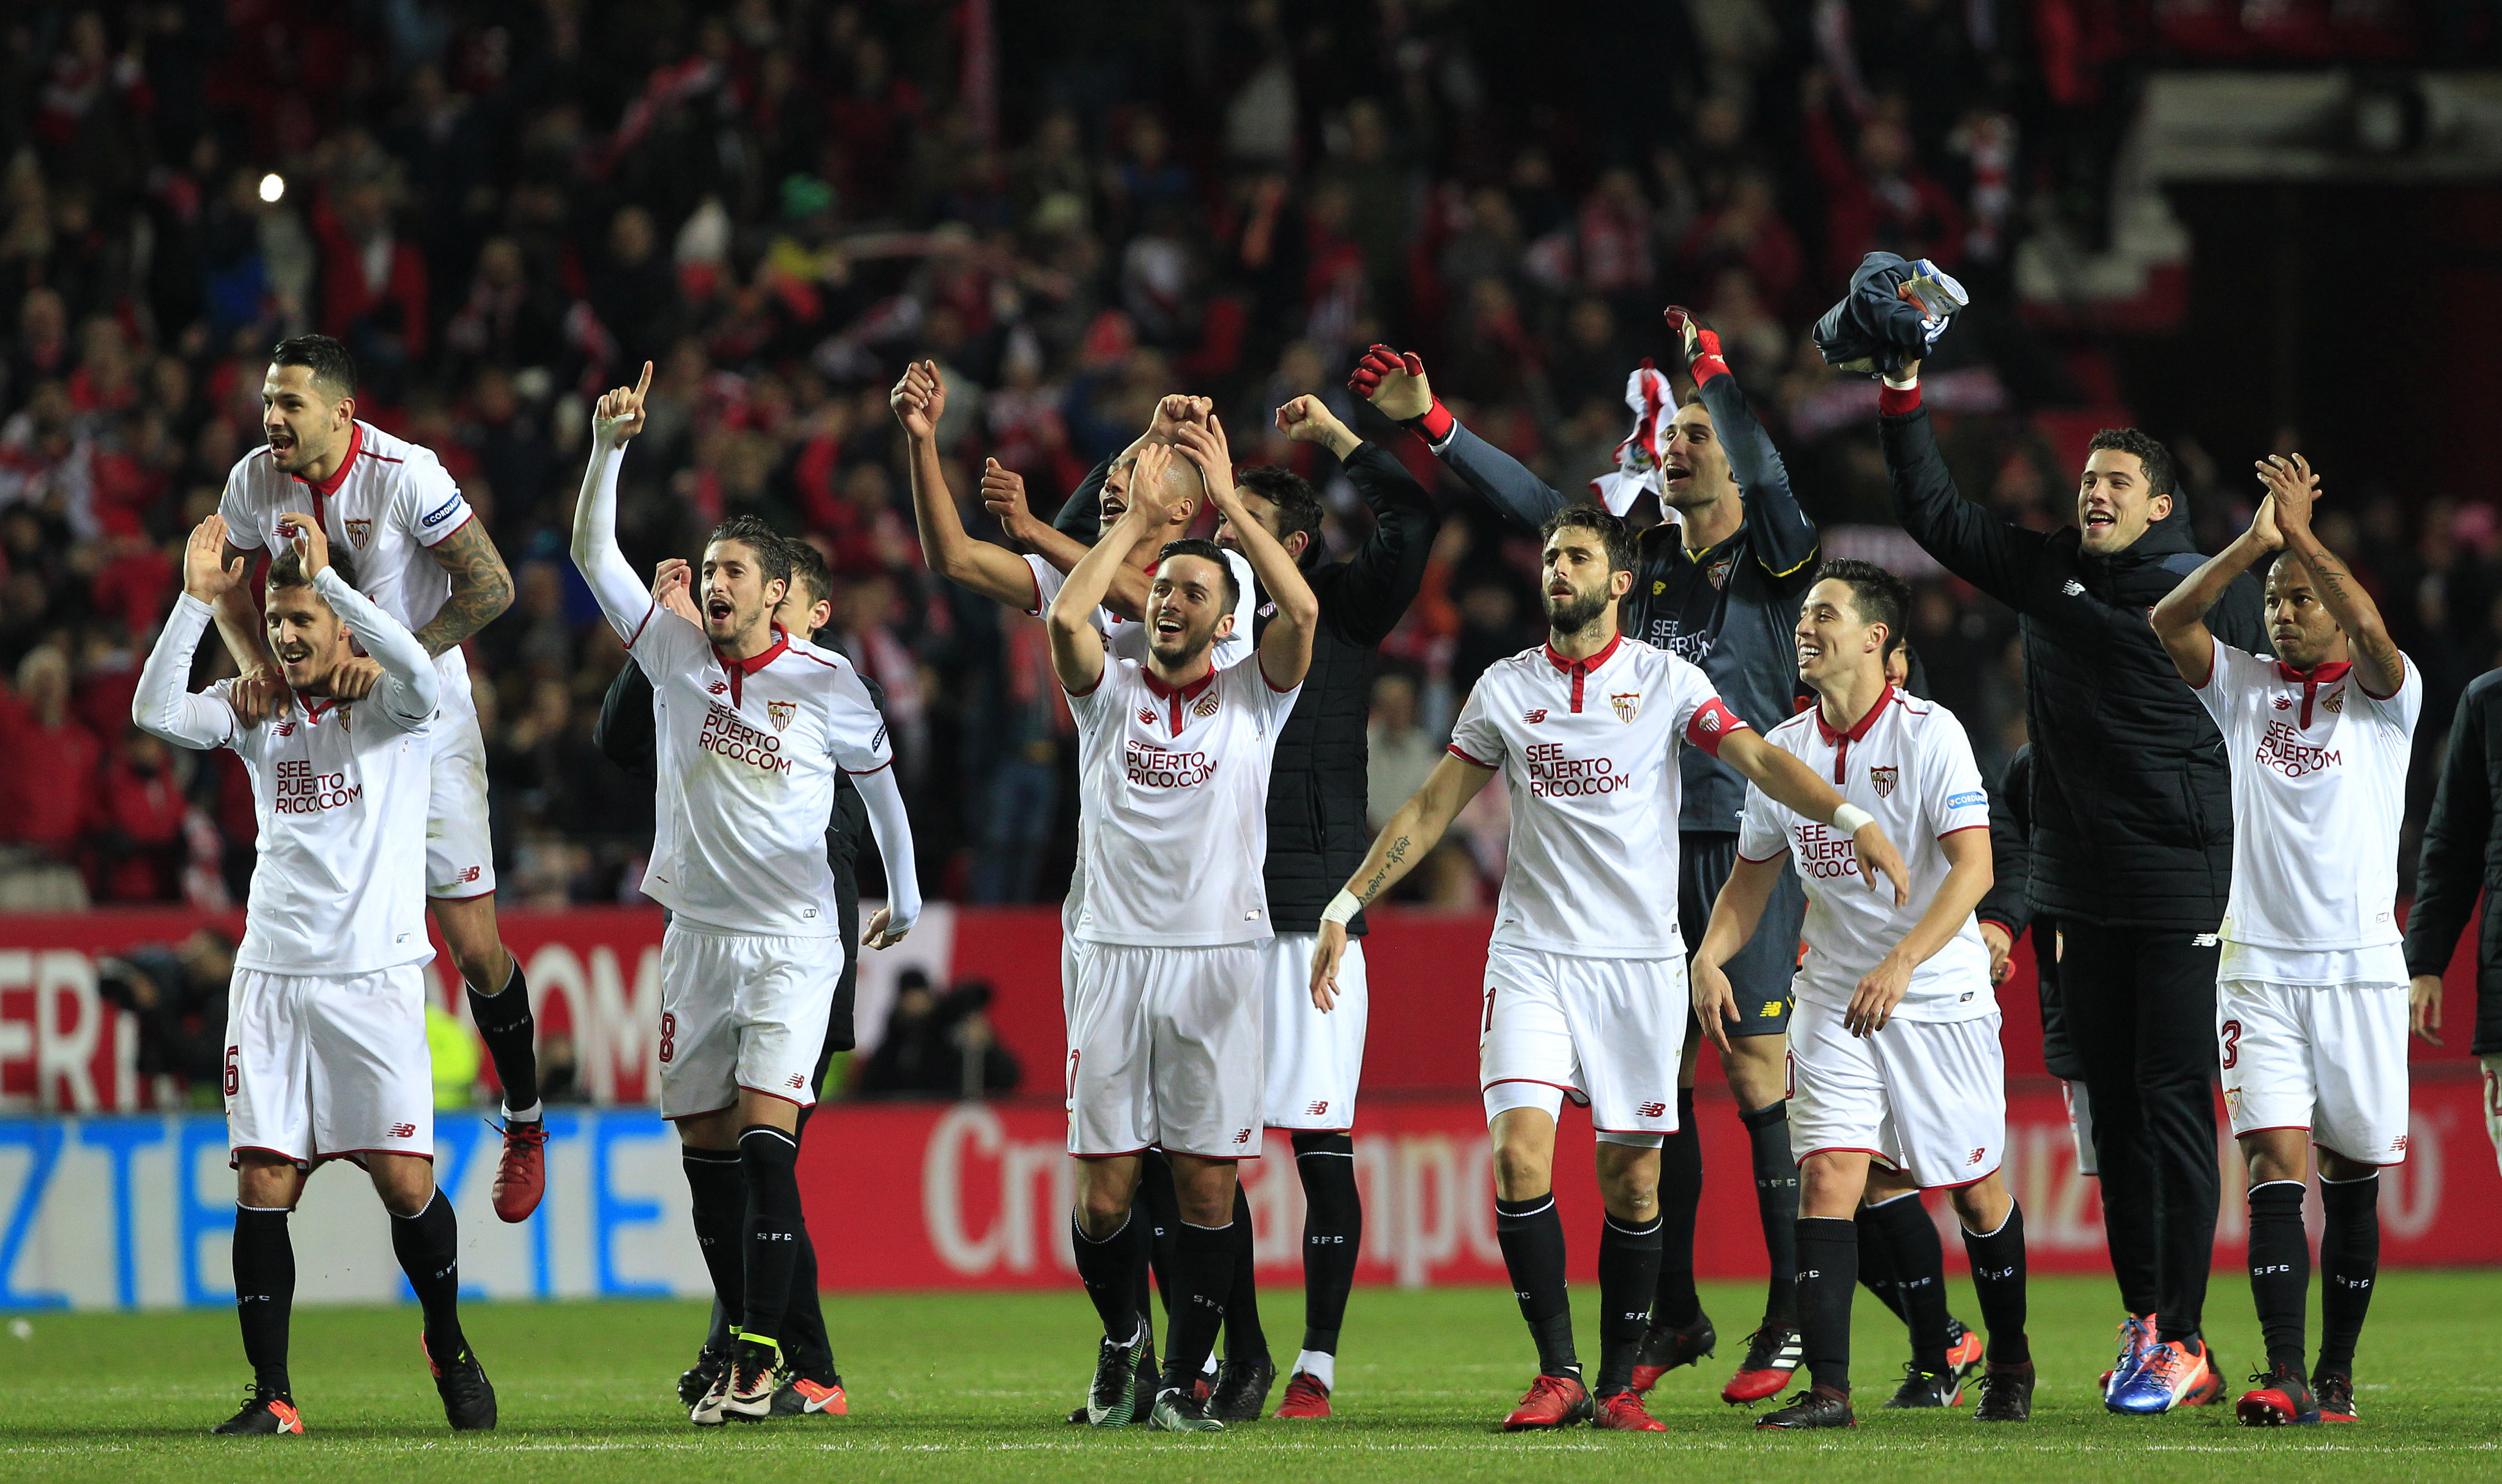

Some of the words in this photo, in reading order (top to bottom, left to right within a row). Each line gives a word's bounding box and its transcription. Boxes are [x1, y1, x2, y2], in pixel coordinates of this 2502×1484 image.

[1651, 619, 1678, 637] SEE
[709, 700, 741, 723] SEE
[703, 713, 780, 752] PUERTO
[2267, 719, 2295, 742] SEE
[699, 731, 792, 775] RICO.COM
[1126, 751, 1205, 770] PUERTO
[1526, 743, 1564, 762] SEE
[2260, 736, 2324, 764] PUERT
[277, 760, 311, 779] SEE
[1127, 760, 1217, 788] RICO.COM
[1529, 757, 1612, 780] PUERTO
[277, 772, 344, 796] PUERTO
[1530, 773, 1629, 798] RICO.COM
[275, 784, 362, 814] RICO.COM
[1795, 824, 1828, 842] SEE
[1800, 839, 1853, 860] PUERT
[1801, 858, 1879, 878] RICO.C
[659, 1012, 675, 1063] 8
[2221, 1020, 2241, 1070] 3
[225, 1045, 239, 1097] 6
[1758, 1178, 1797, 1188] SFC
[0, 1112, 239, 1309] ZTE
[389, 1110, 675, 1301] ZTE
[757, 1232, 793, 1241] SFC
[1312, 1236, 1344, 1244] SFC
[1979, 1266, 2013, 1281] SFC
[2254, 1264, 2290, 1276] SFC
[2336, 1274, 2369, 1289] SFC
[1193, 1295, 1224, 1314] SFC
